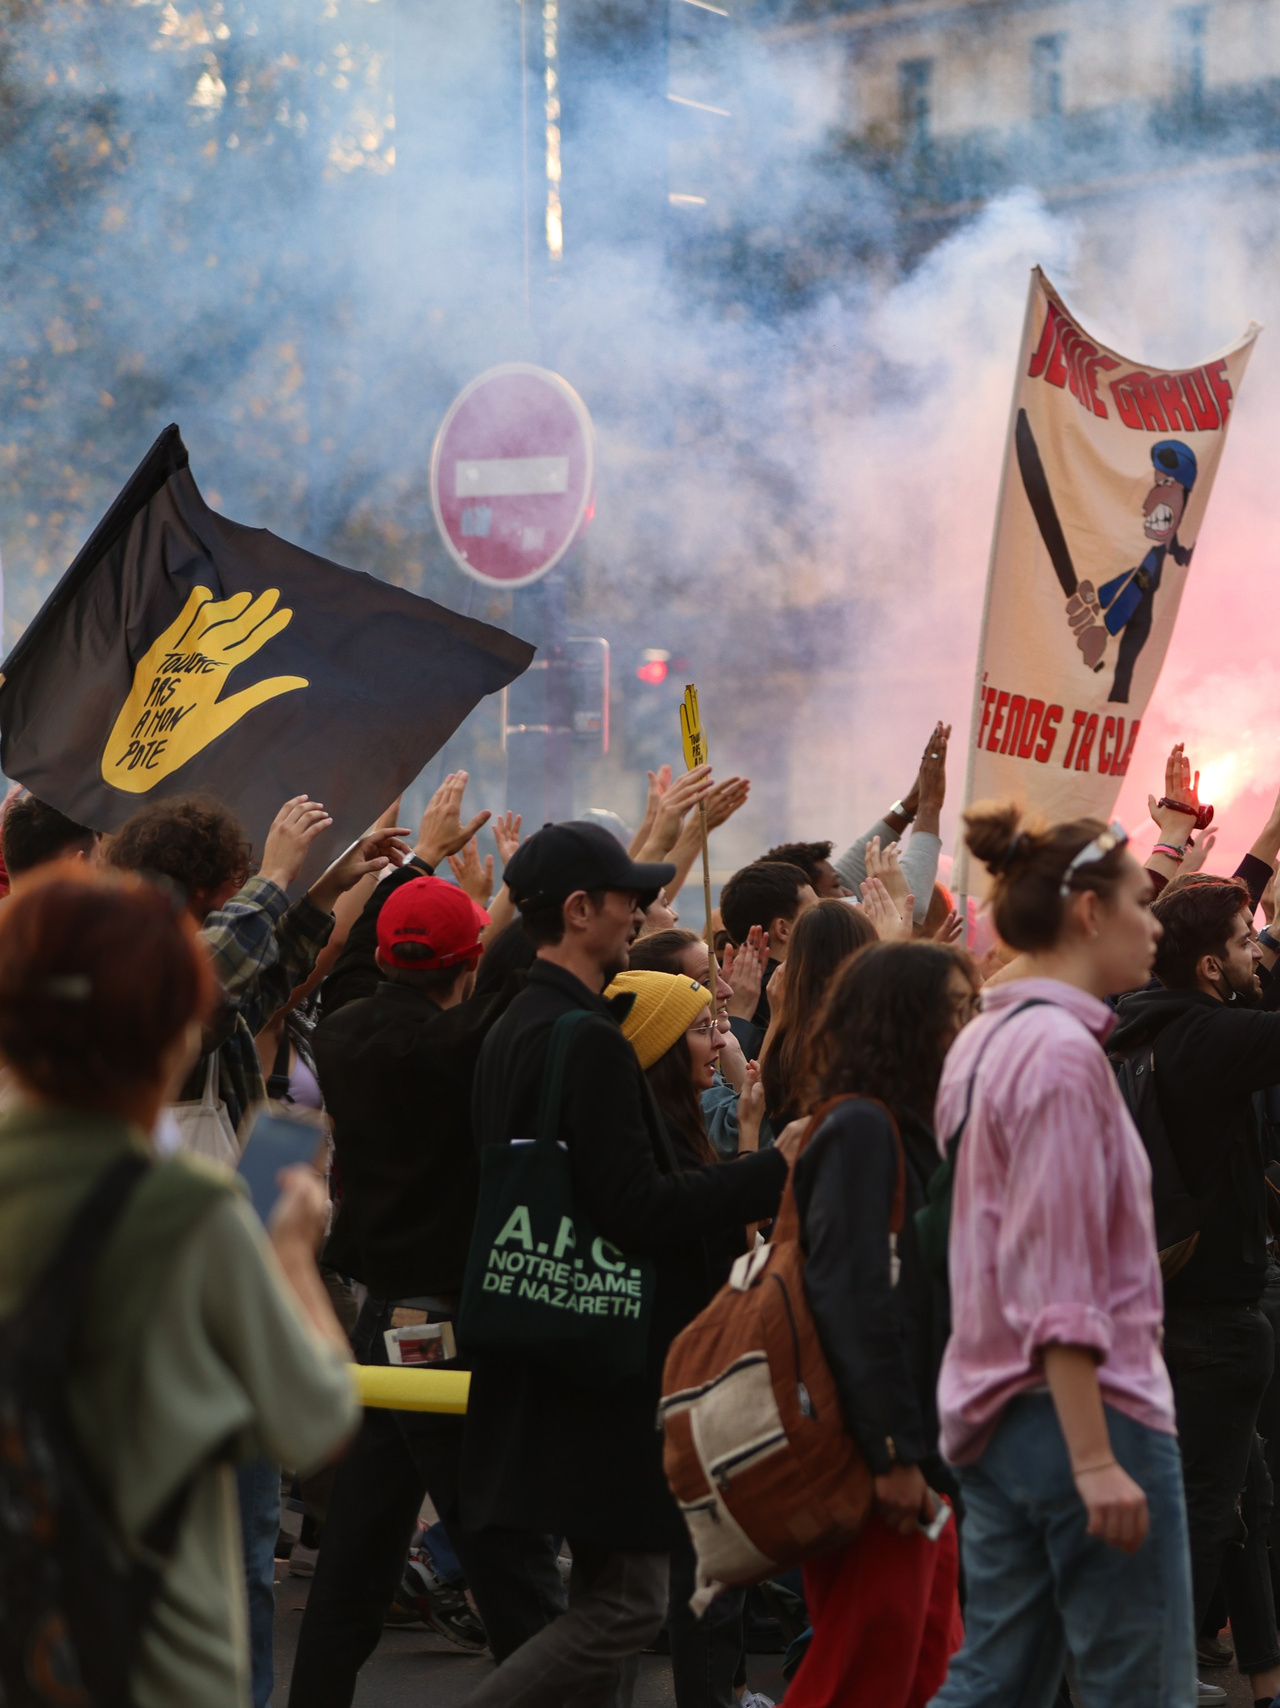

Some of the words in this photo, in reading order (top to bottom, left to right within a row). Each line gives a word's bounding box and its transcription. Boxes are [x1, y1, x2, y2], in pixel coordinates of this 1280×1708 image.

[143, 676, 181, 707] PAS
[977, 673, 1064, 763] FENDS
[1063, 709, 1099, 772] TA
[115, 739, 169, 770] POTE
[482, 1272, 515, 1294] DE
[518, 1278, 642, 1319] NAZARETH
[488, 1248, 643, 1298] NOTRE-DAME
